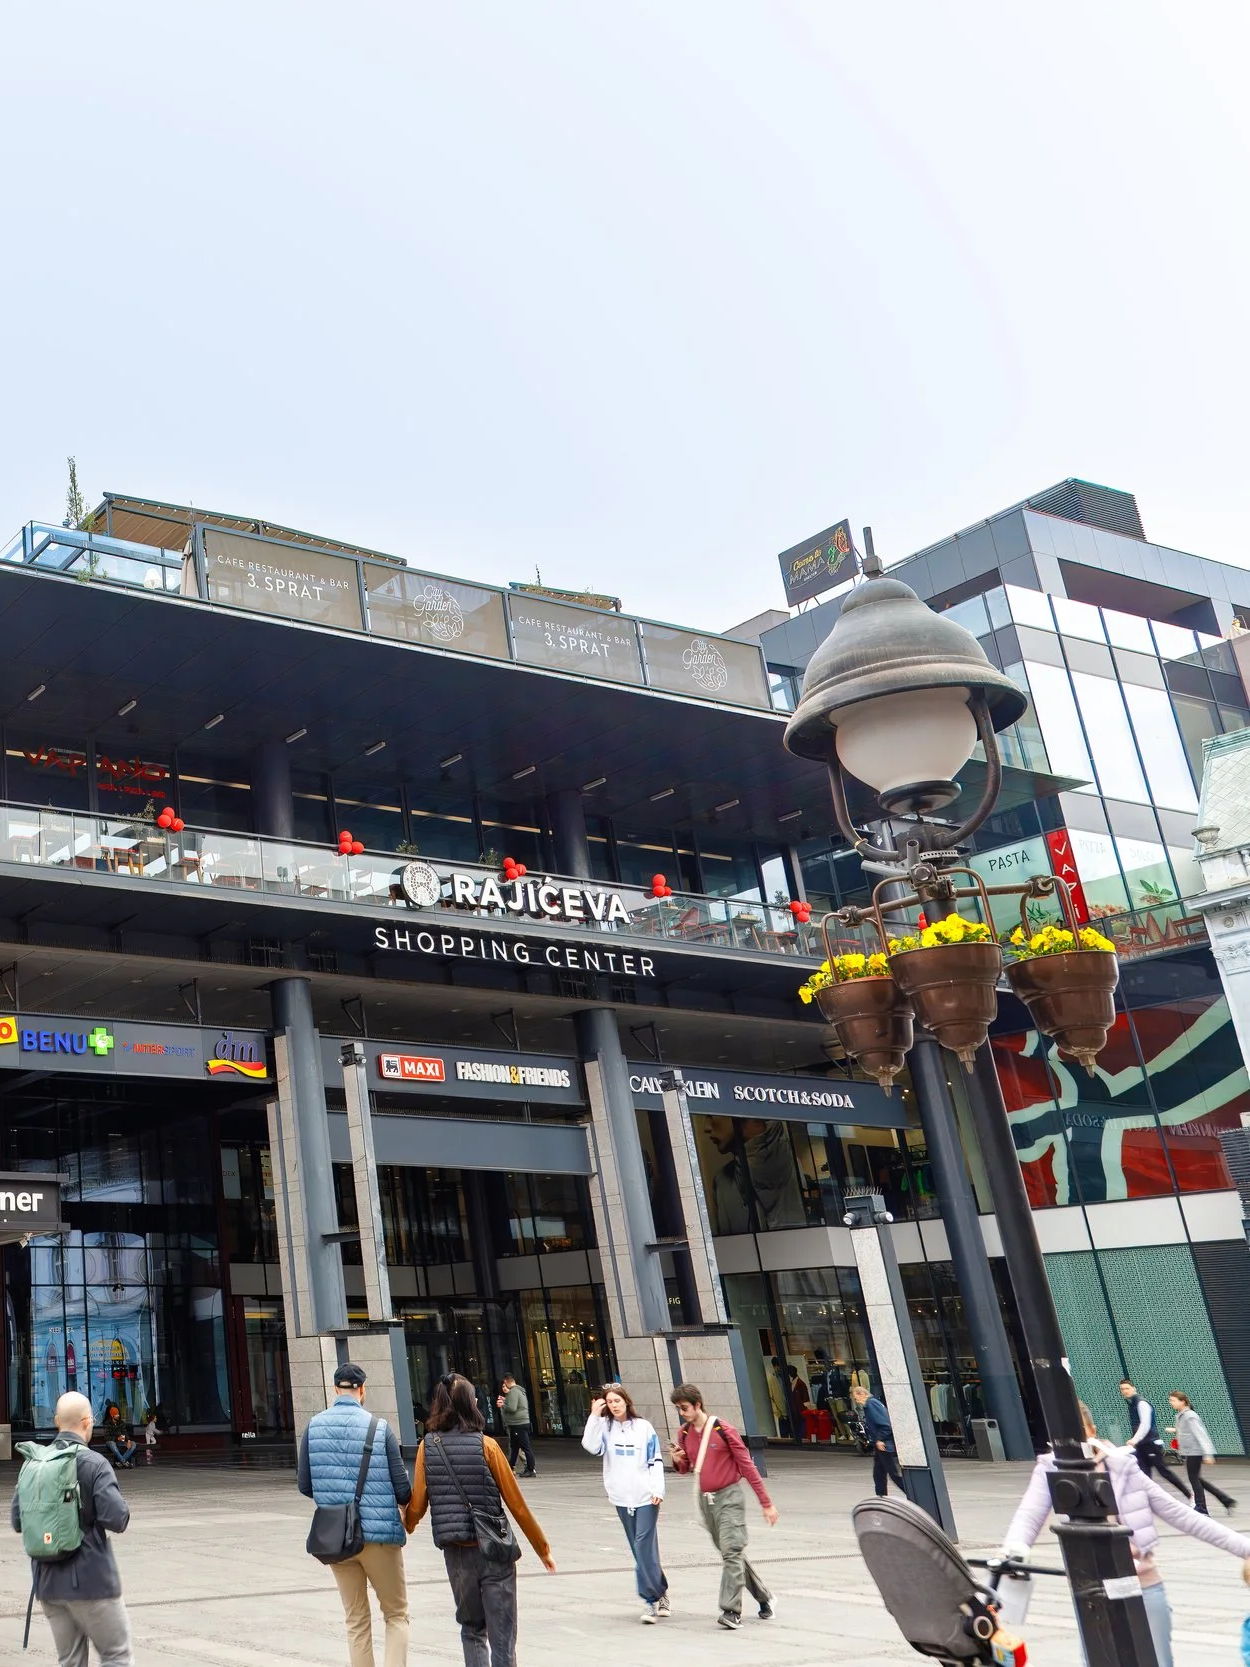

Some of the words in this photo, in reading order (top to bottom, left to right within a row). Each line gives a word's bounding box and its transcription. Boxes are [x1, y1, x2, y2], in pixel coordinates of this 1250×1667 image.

[217, 555, 245, 568] CAFE
[248, 561, 316, 583] RESTAURANT
[330, 578, 349, 590] BAR
[790, 556, 825, 585] MAMA
[247, 573, 260, 589] 3.
[264, 575, 323, 601] SPRAT
[423, 584, 443, 602] City
[413, 594, 452, 616] Garden
[518, 616, 542, 628] CAFE
[544, 621, 603, 640] RESTAURANT
[614, 636, 631, 647] BAR
[544, 632, 556, 649] 3.
[559, 636, 610, 658] SPRAT
[690, 639, 708, 656] City
[682, 649, 717, 669] Garden
[23, 743, 166, 781] VAPANO
[988, 850, 1030, 871] PASTA
[451, 873, 631, 924] RAJIĆEVA
[374, 927, 530, 964] SHOPPING
[545, 945, 655, 977] CENTER
[22, 1029, 88, 1054] BENU
[132, 1043, 196, 1057] INTERSPORT
[215, 1031, 258, 1062] dm
[403, 1061, 440, 1077] MAXI
[456, 1061, 571, 1088] FASHION&FRIENDS
[629, 1075, 665, 1094] CALV
[684, 1080, 720, 1099] KLEIN
[734, 1085, 855, 1109] SCOTCH&SODA
